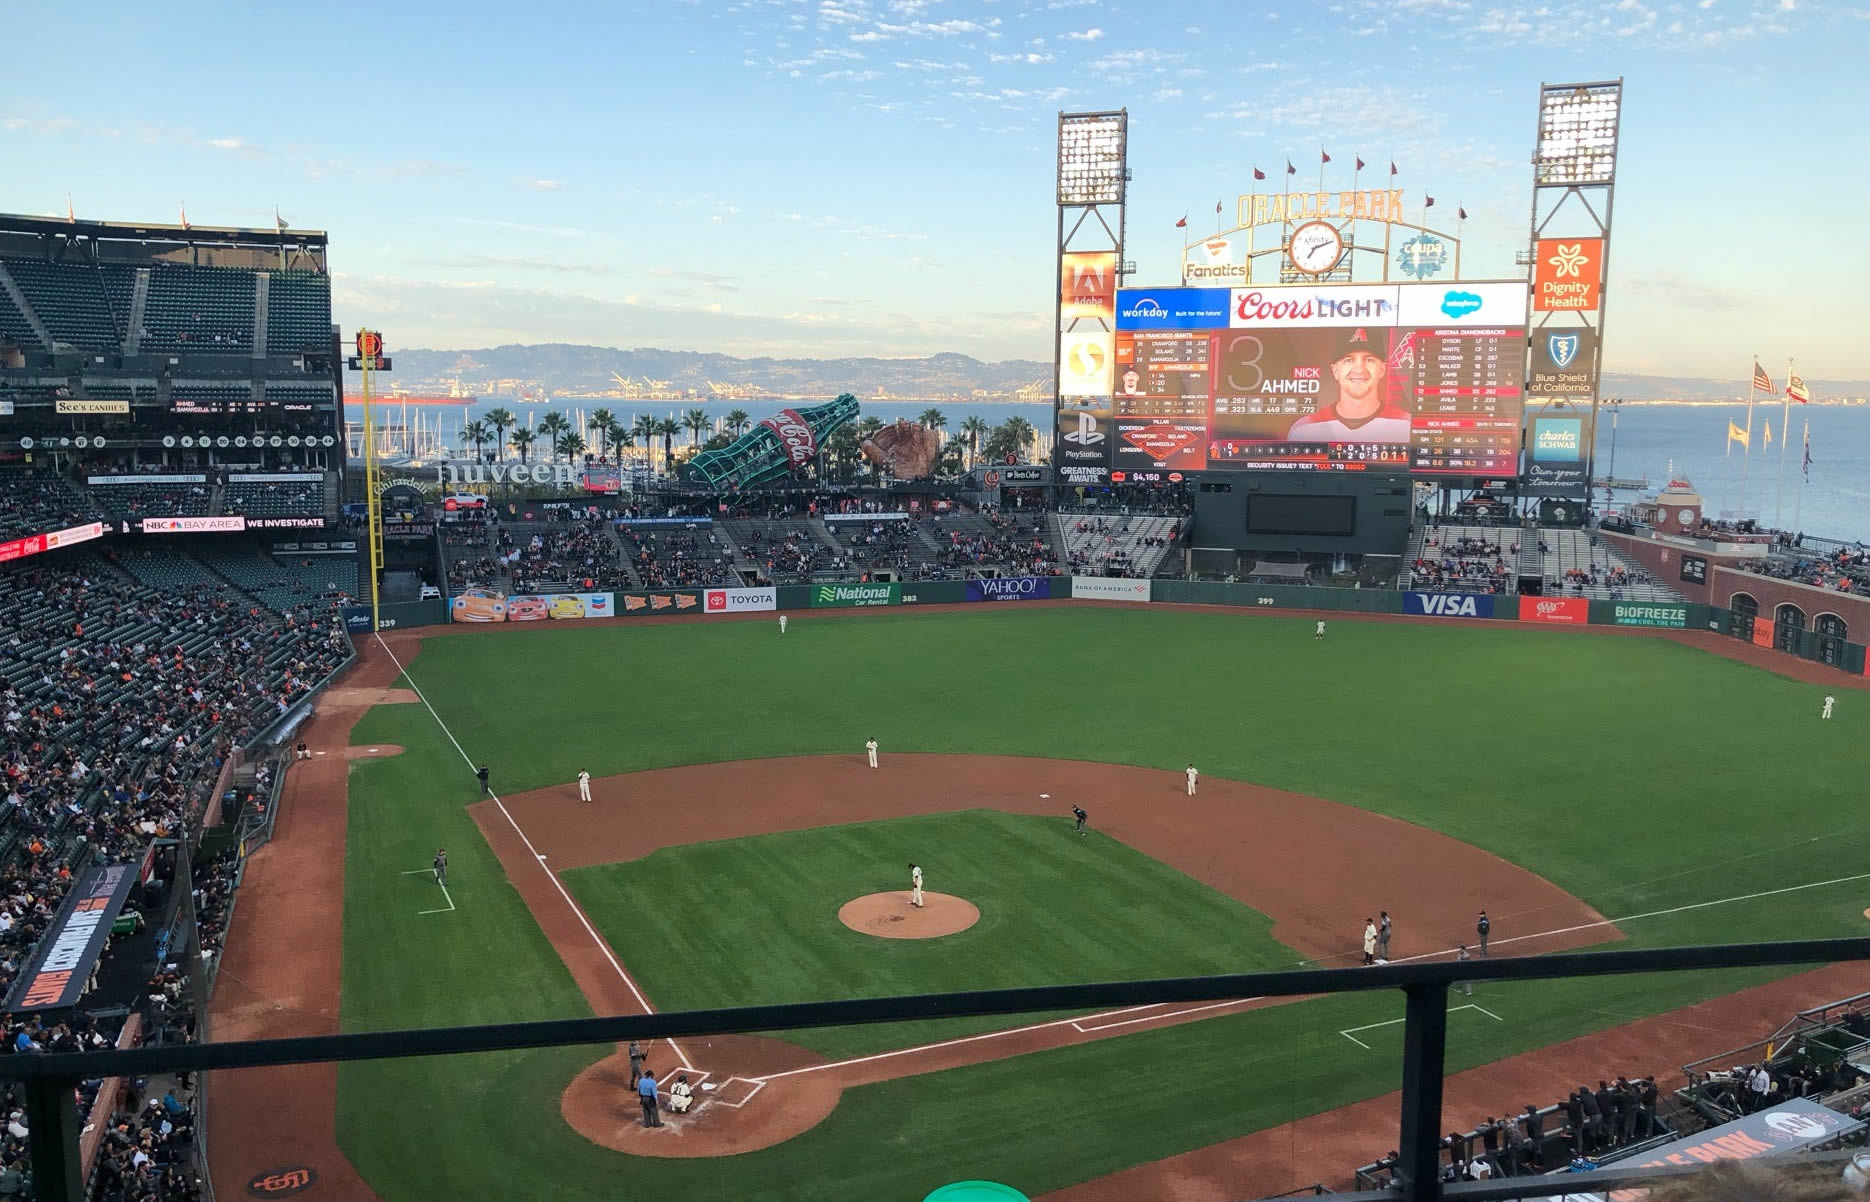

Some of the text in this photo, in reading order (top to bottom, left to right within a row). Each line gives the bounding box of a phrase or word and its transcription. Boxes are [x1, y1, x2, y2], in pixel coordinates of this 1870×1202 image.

[1237, 189, 1404, 227] ORACLE PARK
[1186, 263, 1246, 278] Fanatics
[1543, 282, 1590, 296] Dignity
[1074, 296, 1103, 306] Adobe
[1237, 292, 1385, 320] Coors LIGHT
[1544, 295, 1588, 307] Health
[1122, 308, 1168, 319] workday
[1294, 368, 1320, 379] NICK
[1535, 373, 1587, 382] Blue Shield
[1260, 379, 1320, 393] AHMED
[1532, 383, 1590, 392] of California
[60, 402, 87, 411] See's
[1539, 430, 1576, 441] charles
[1065, 450, 1103, 459] PlayStation
[436, 462, 580, 484] nuveen
[1060, 466, 1107, 475] GREATNESS
[1530, 465, 1582, 480] Own your
[1132, 473, 1160, 481] $4,150
[1529, 477, 1582, 487] tomorrow
[373, 477, 427, 496] Ghirardelli
[146, 519, 242, 529] NBC BAY AREA
[247, 518, 324, 528] WE INVESTIGATE
[383, 525, 410, 536] RACLE
[980, 578, 1037, 596] YAHOO!
[1102, 585, 1132, 593] AMERICA
[730, 594, 774, 604] TOYOTA
[836, 586, 891, 601] National
[1257, 597, 1274, 605] 399
[1417, 594, 1477, 616] VISA
[379, 618, 396, 628] 339
[21, 970, 73, 1007] GIANTS
[1684, 1130, 1776, 1160] PARK
